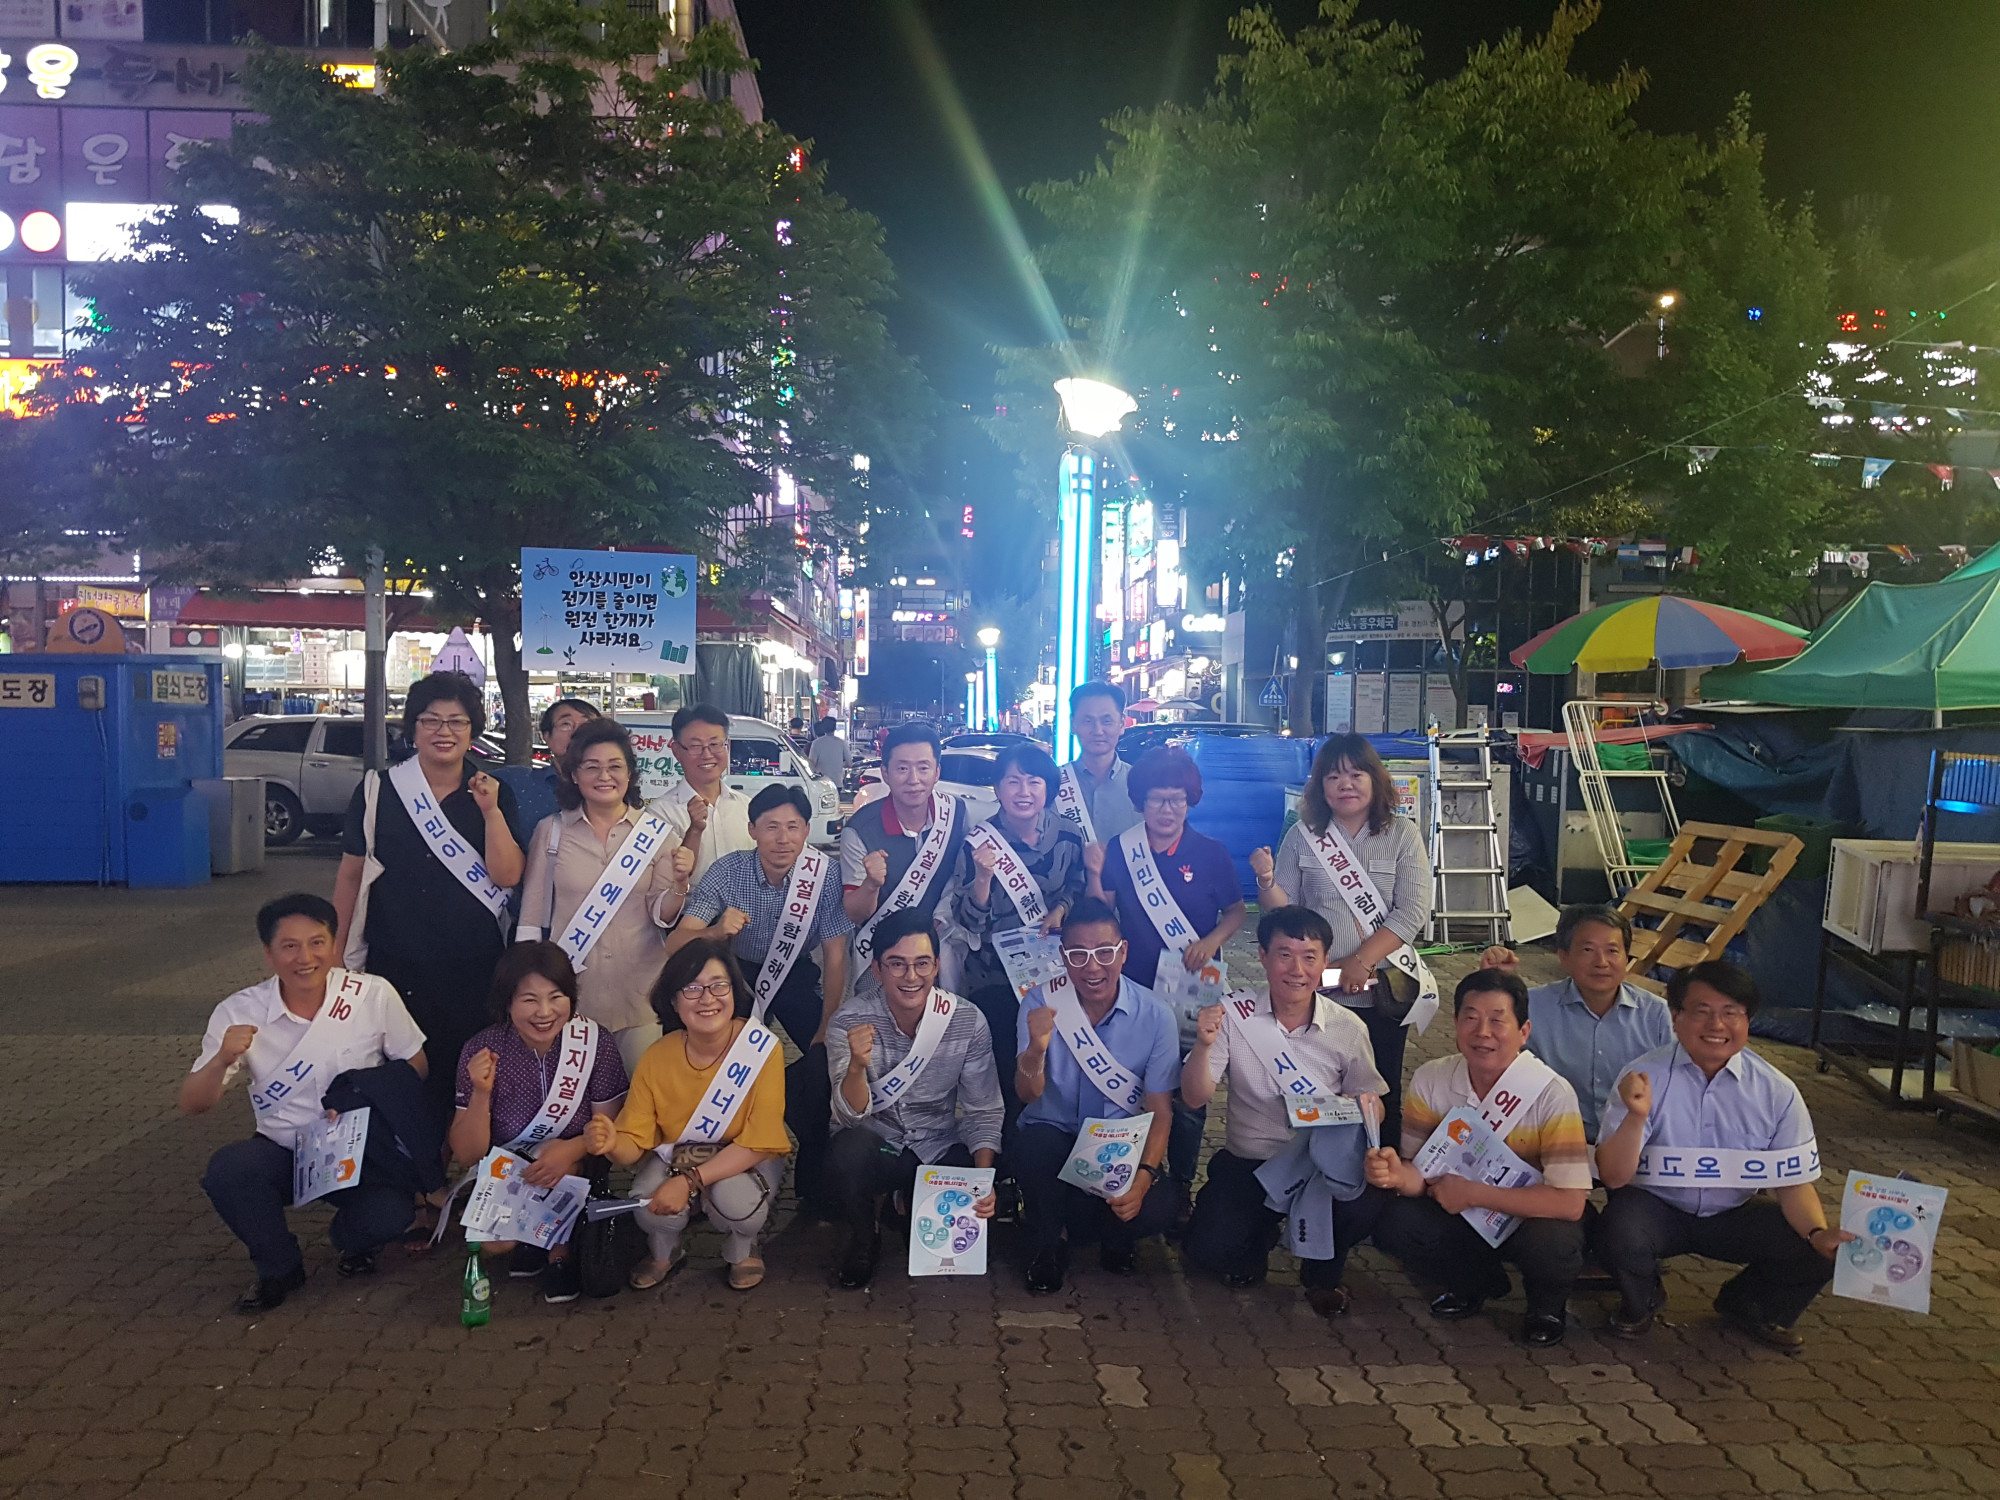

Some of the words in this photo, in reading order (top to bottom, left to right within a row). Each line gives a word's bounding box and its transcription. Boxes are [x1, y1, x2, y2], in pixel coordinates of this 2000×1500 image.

[568, 570, 652, 590] 안산시민이
[561, 590, 608, 610] 전기를
[612, 591, 658, 610] 줄이면
[564, 611, 599, 629] 원전
[602, 611, 655, 630] 한개가
[578, 631, 641, 648] 사라져요
[2, 679, 49, 703] 도장
[413, 792, 466, 859] 시민이
[620, 816, 668, 876] 시민이
[1131, 841, 1168, 908] 시민이
[1073, 1026, 1129, 1092] 시민이
[252, 1059, 314, 1111] 시민이
